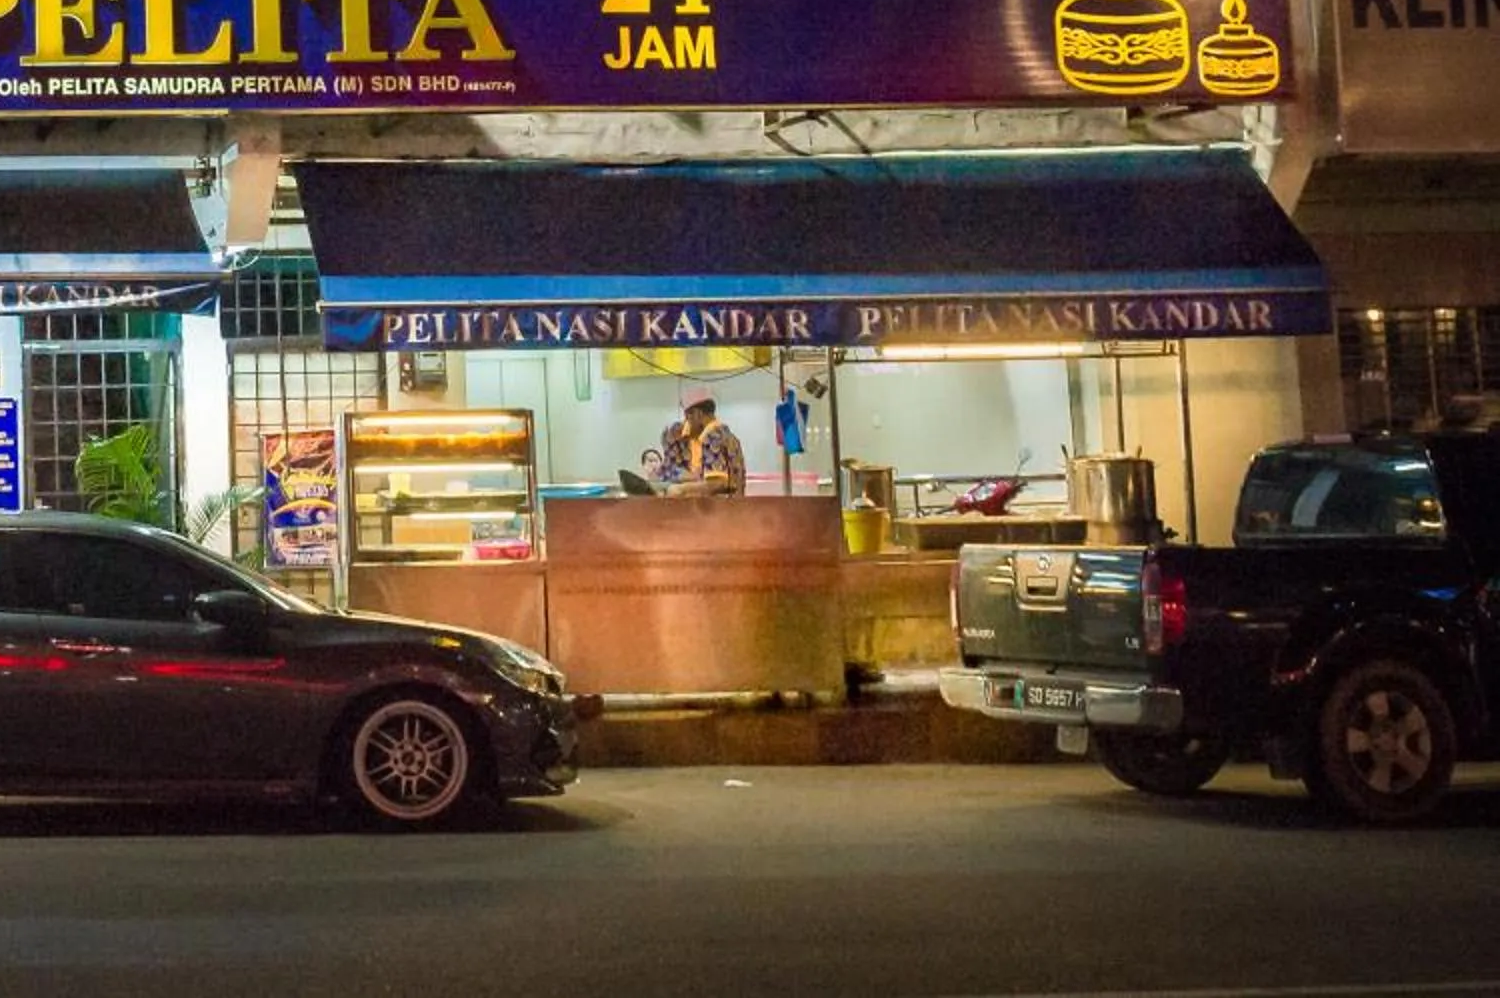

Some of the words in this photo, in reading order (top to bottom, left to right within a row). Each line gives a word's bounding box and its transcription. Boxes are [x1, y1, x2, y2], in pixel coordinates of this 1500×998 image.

[603, 24, 717, 70] JAM
[47, 77, 119, 96] PELITA
[124, 77, 225, 95] SAMUDRA
[230, 76, 327, 94] PERTAMA
[333, 76, 363, 96] (M)
[371, 75, 412, 92] SDN
[418, 75, 460, 91] BHD
[383, 312, 524, 344] PELITA
[536, 311, 627, 342] NASI
[642, 310, 812, 340] KANDAR
[857, 304, 998, 336] PELITA
[1006, 304, 1095, 334] NASI
[1110, 301, 1273, 331] KANDAR
